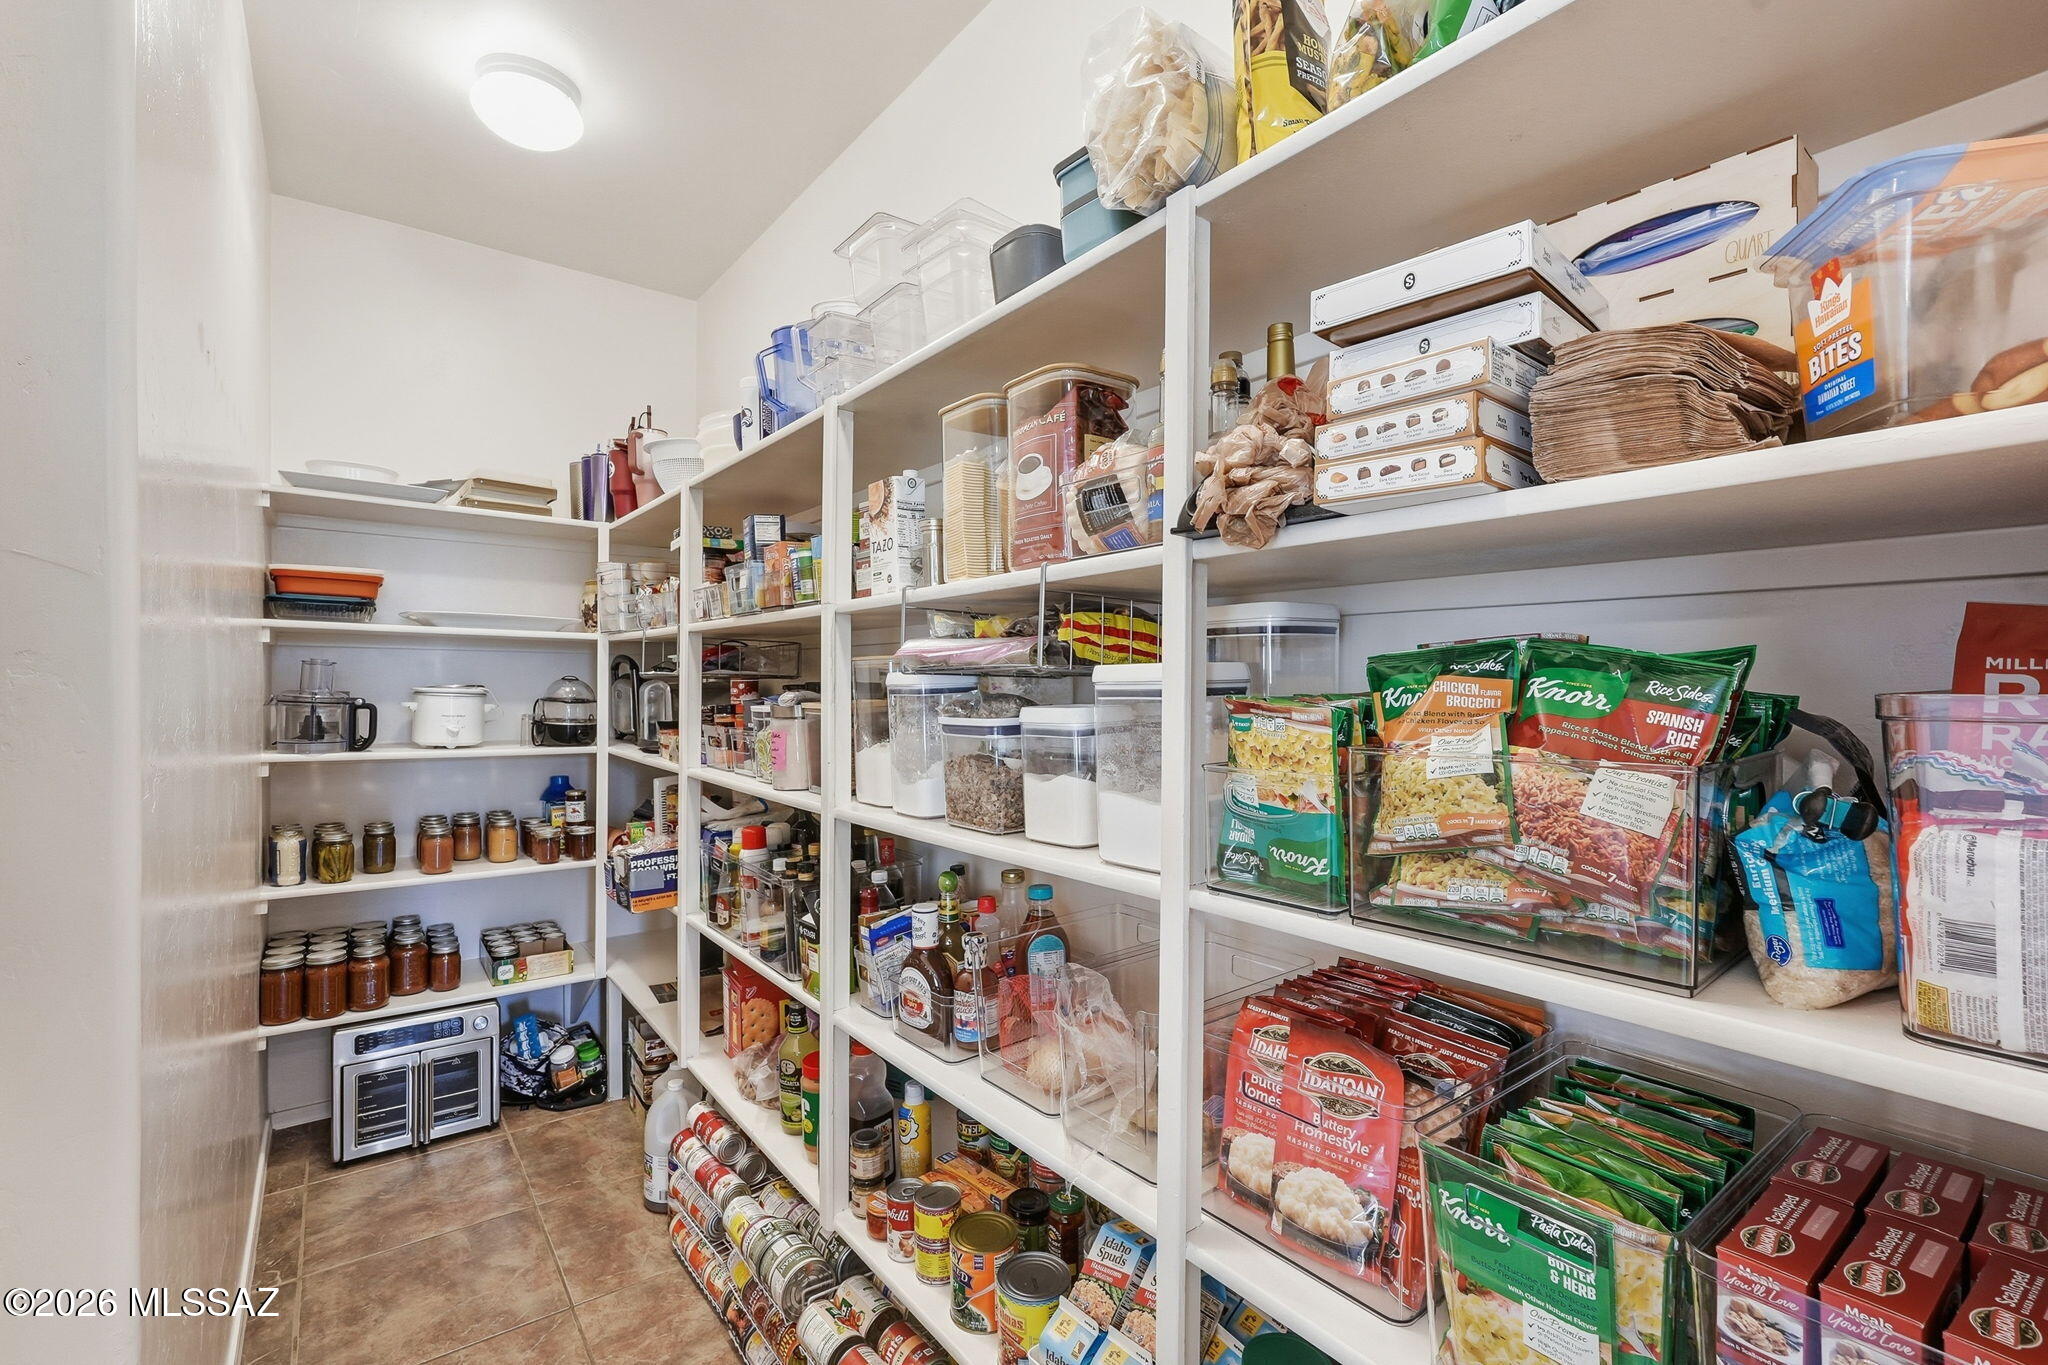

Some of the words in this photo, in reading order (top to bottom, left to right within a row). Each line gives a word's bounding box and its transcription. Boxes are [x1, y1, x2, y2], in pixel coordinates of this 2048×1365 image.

[1725, 230, 1774, 264] QUART
[1808, 331, 1863, 385] BITES
[871, 537, 894, 554] TAZO
[1985, 657, 2048, 670] MILL
[1432, 680, 1479, 696] CHICKEN
[1446, 694, 1502, 709] BROCCOLI
[1526, 677, 1612, 713] Knorr
[1645, 680, 1676, 698] Rice
[1676, 684, 1714, 705] Sides
[1562, 721, 1580, 732] Rice
[1582, 725, 1590, 733] &
[1592, 728, 1619, 743] Pasta
[1621, 738, 1648, 752] Blend
[1646, 709, 1706, 735] SPANISH
[1589, 736, 1619, 751] Sweet
[1620, 746, 1657, 762] Tomato
[1666, 729, 1702, 750] RICE
[1627, 772, 1669, 790] Promise
[1467, 816, 1475, 826] 7
[1269, 845, 1330, 876] Knorr
[1966, 841, 1977, 878] Maruchan
[1607, 872, 1617, 883] 7
[1762, 868, 1780, 915] Medium
[1768, 936, 1788, 965] Kroger
[1440, 1048, 1453, 1057] JUST
[1453, 1053, 1466, 1062] ADD
[1466, 1057, 1490, 1070] WATER
[1303, 1069, 1380, 1099] IDAHOAN
[1294, 1120, 1370, 1156] Homestyle
[1313, 1112, 1357, 1139] Buttery
[1286, 1135, 1321, 1153] MASHED
[1325, 1150, 1377, 1173] POTATOES
[1438, 1188, 1511, 1247] Knorr
[1765, 1193, 1800, 1226] Scalloped
[1102, 1236, 1132, 1255] Idaho
[1530, 1212, 1560, 1239] Pasta
[1558, 1231, 1598, 1257] Sides
[1754, 1225, 1778, 1257] IDAHOAN
[1869, 1226, 1904, 1260] Scalloped
[1096, 1247, 1128, 1267] Spuds
[1547, 1251, 1596, 1286] BUTTER
[1549, 1269, 1560, 1284] &
[1563, 1275, 1597, 1301] HERB
[1723, 1271, 1767, 1298] You'll
[1769, 1290, 1800, 1311] Love
[1737, 1264, 1781, 1292] Meals
[1863, 1262, 1885, 1294] IDAHOAN
[1994, 1268, 2032, 1308] Scalloped
[1529, 1308, 1549, 1323] Our
[1550, 1316, 1588, 1343] Promise
[1574, 1315, 1598, 1332] Flavor
[1827, 1313, 1878, 1341] You'll
[1880, 1335, 1916, 1356] Love
[1845, 1303, 1896, 1336] Meals
[1993, 1311, 2016, 1347] IDAHOAN
